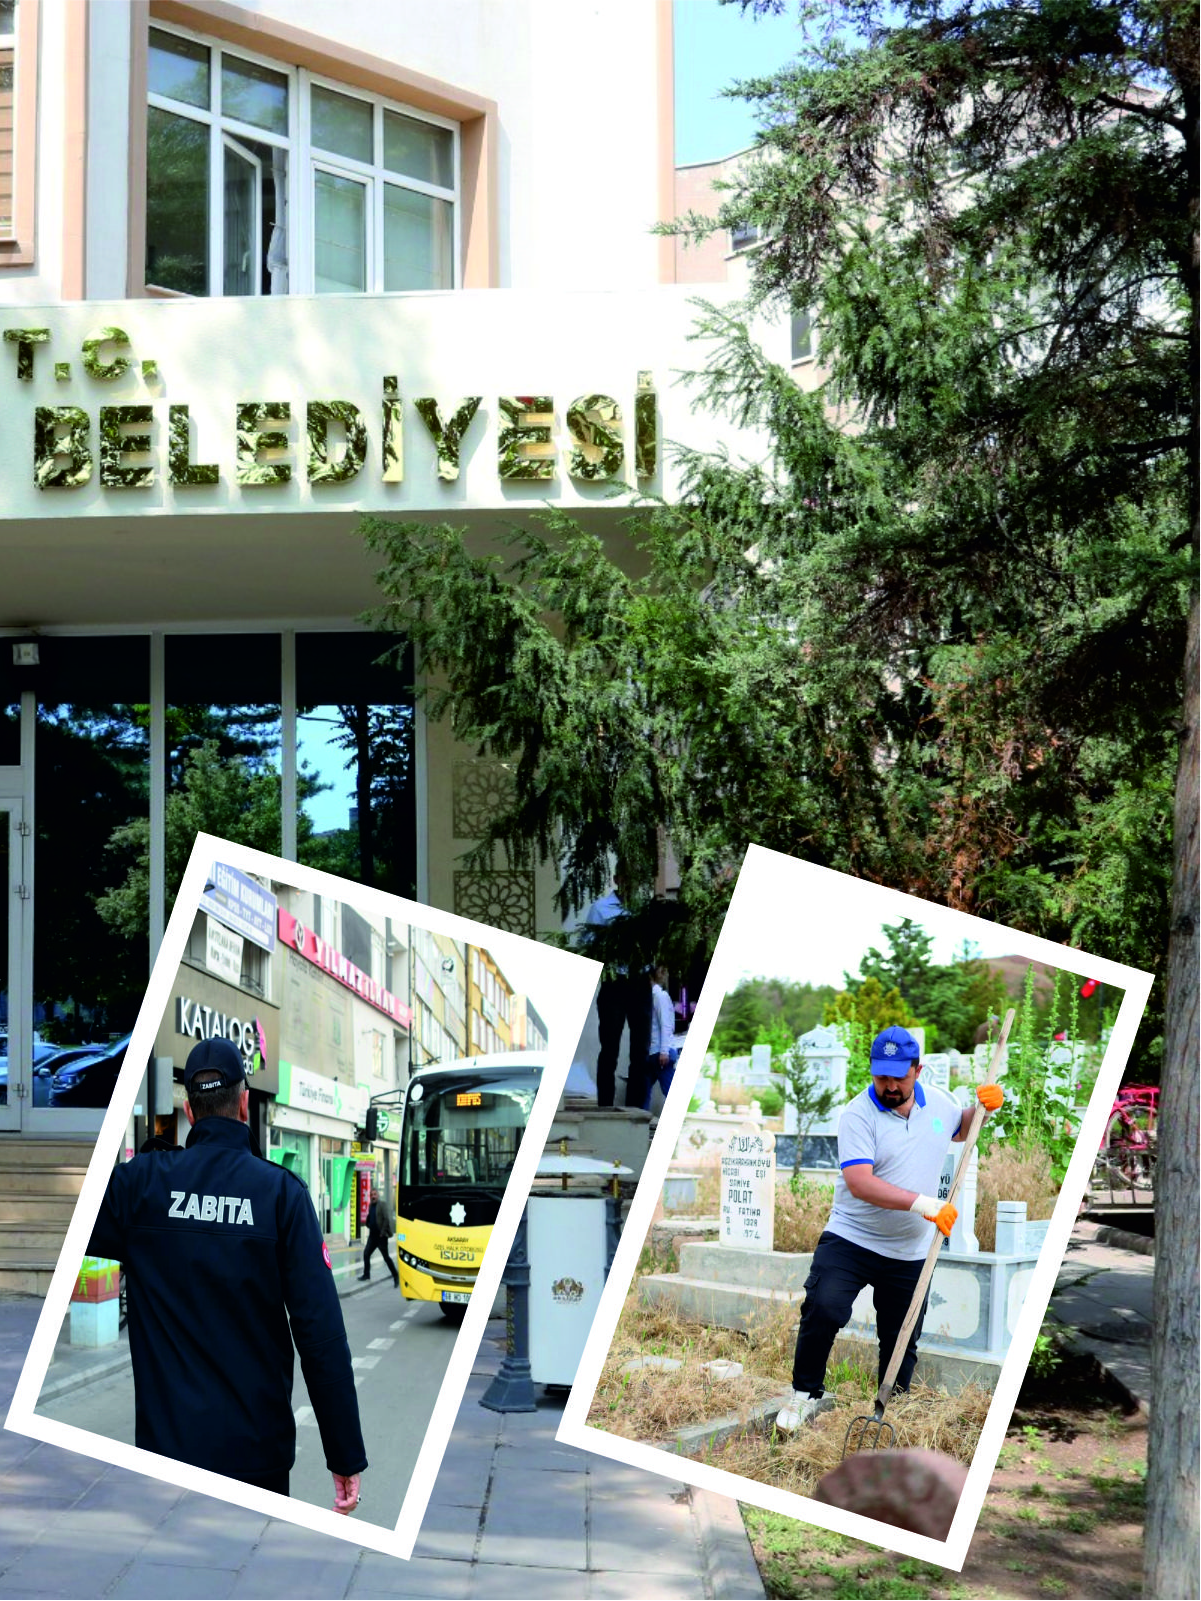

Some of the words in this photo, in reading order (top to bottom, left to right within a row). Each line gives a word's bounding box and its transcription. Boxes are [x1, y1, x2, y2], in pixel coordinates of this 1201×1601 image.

[3, 326, 157, 381] T.C.
[34, 371, 658, 490] BELEDİYESİ
[314, 935, 362, 994] YILMAZ
[201, 1081, 221, 1090] ZABITA
[168, 1190, 255, 1226] ZABITA
[728, 1189, 753, 1204] POLAT
[440, 1250, 475, 1261] ISUZU
